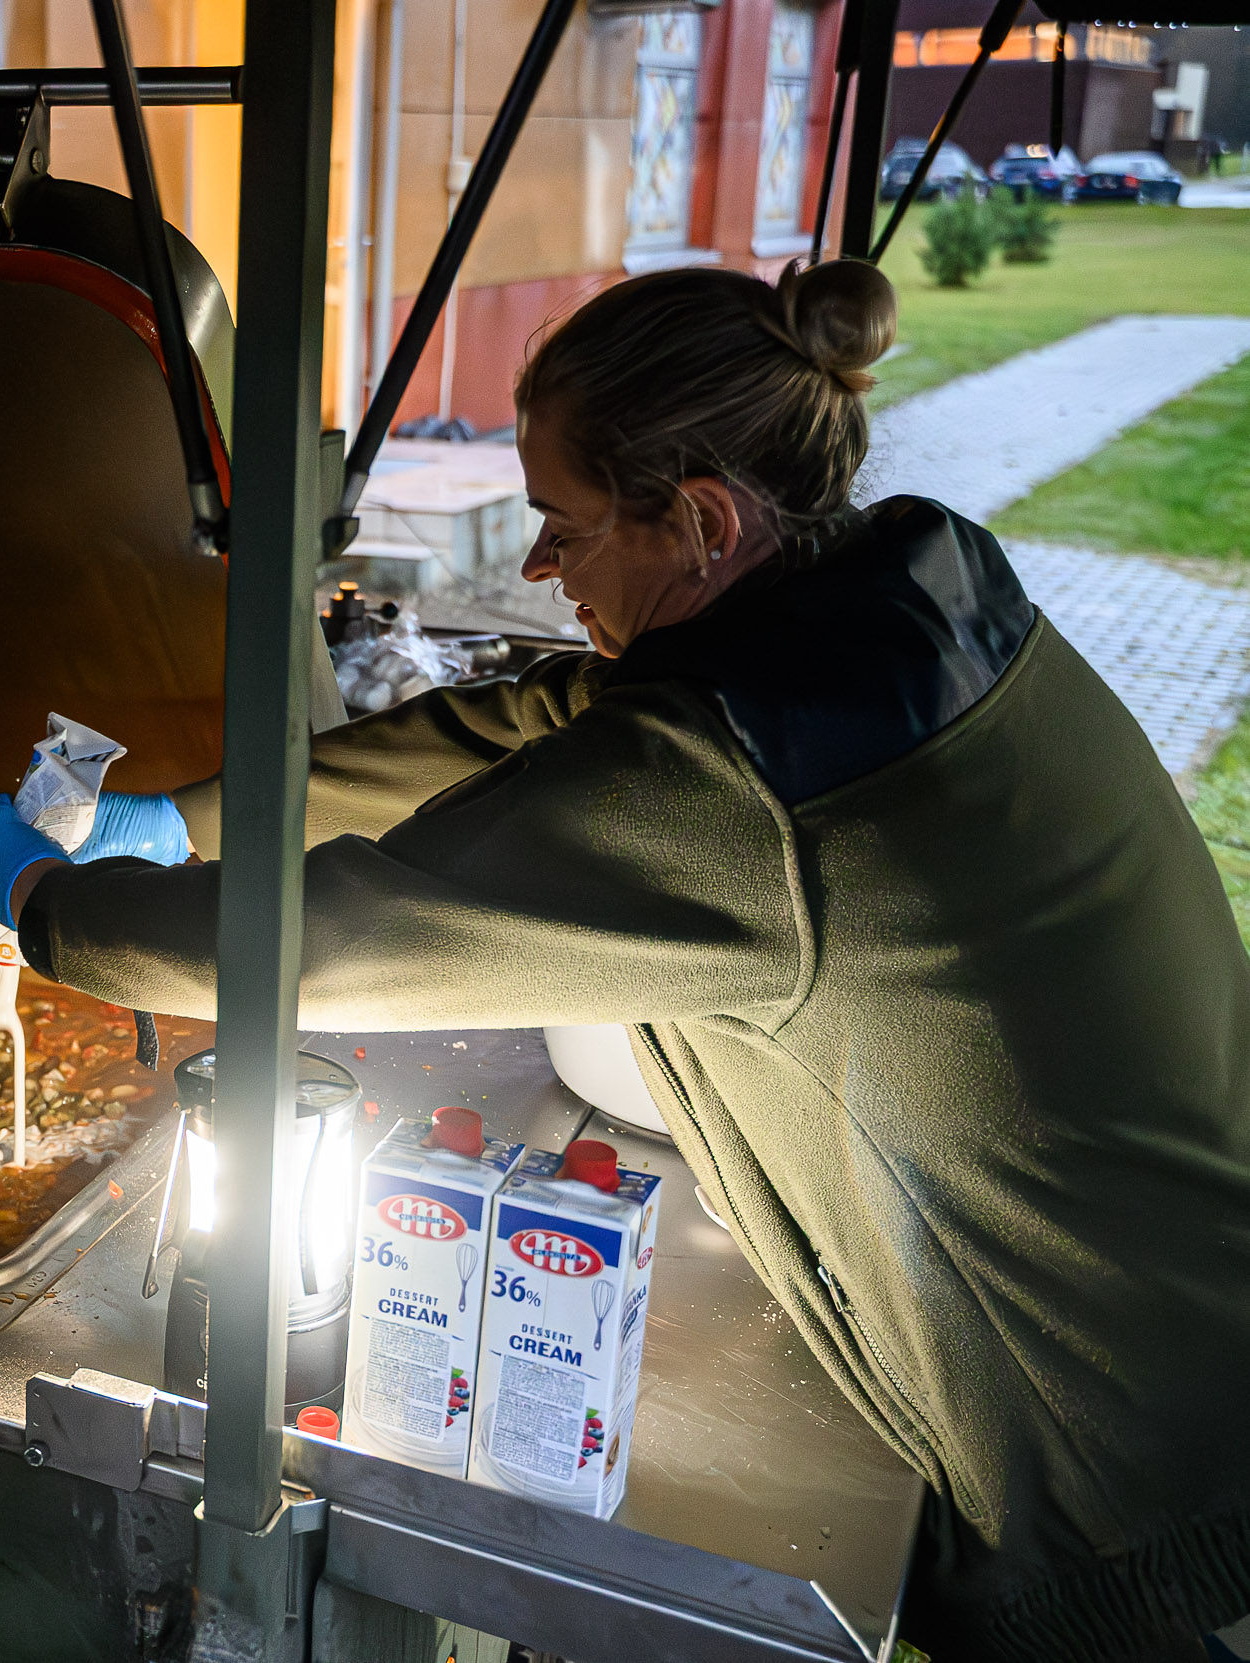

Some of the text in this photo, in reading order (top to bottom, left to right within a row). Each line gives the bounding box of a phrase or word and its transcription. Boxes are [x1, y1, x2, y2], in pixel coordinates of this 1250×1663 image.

[360, 1236, 409, 1271] 36%
[389, 1287, 439, 1307] DESSERT
[491, 1269, 541, 1307] 36%
[378, 1298, 448, 1328] CREAM
[521, 1323, 573, 1345] DESSERT
[509, 1335, 583, 1367] CREAM
